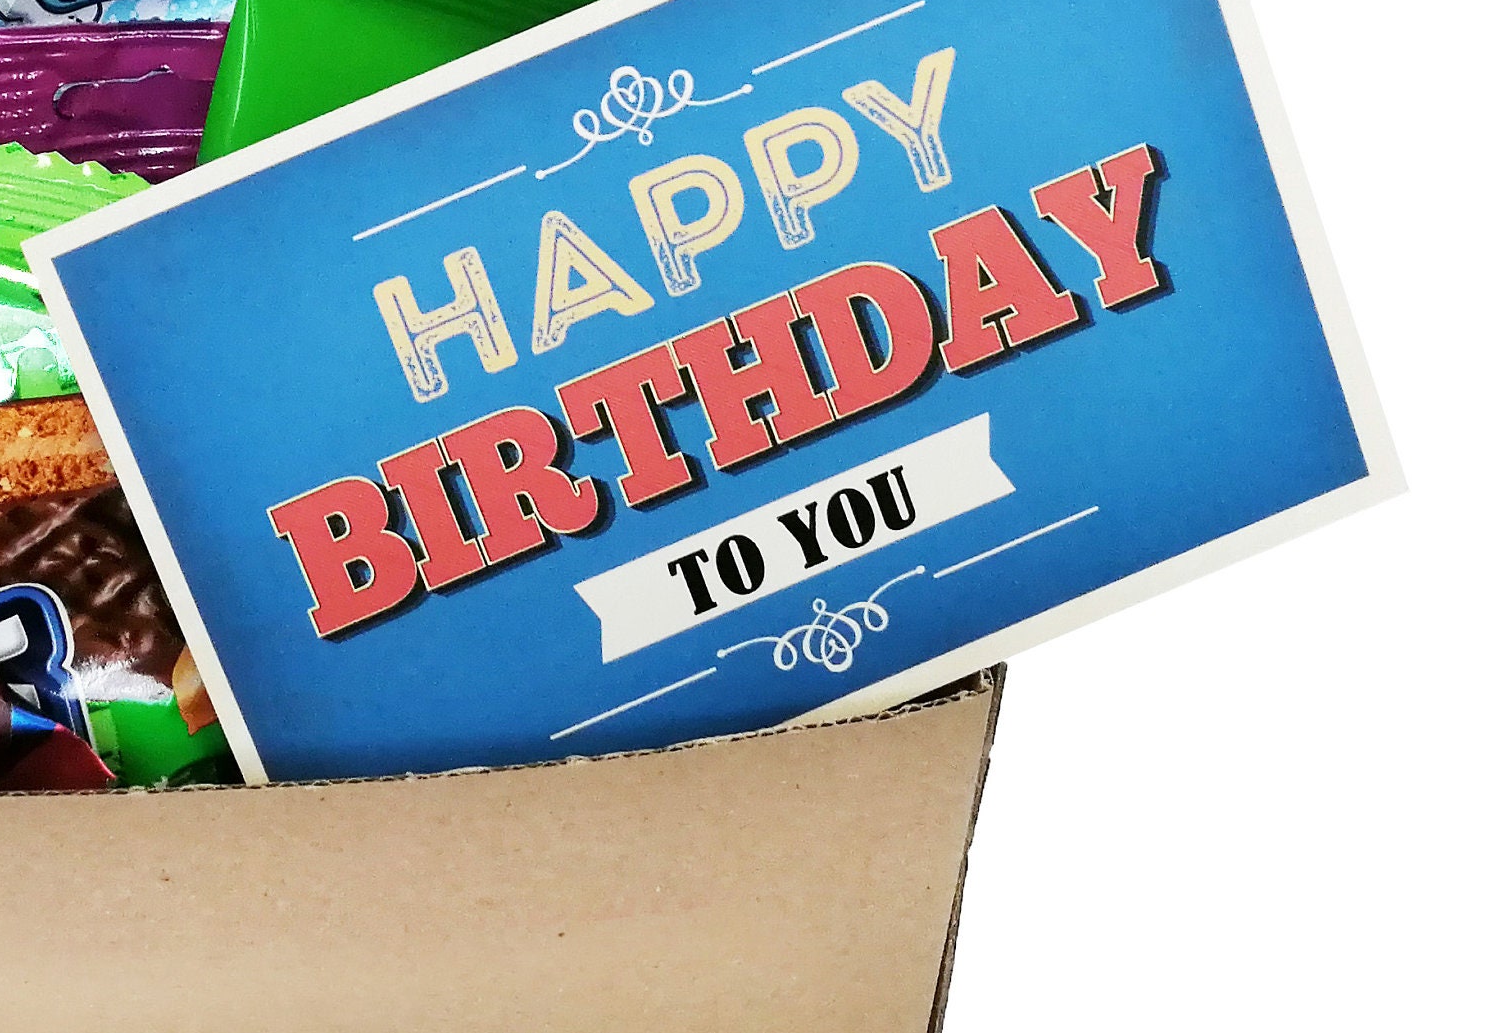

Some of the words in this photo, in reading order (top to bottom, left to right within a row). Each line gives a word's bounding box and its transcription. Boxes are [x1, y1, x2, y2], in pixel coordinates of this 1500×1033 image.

[268, 142, 1168, 640] BIRTHDAY
[371, 46, 956, 404] HAPPY
[667, 539, 765, 617] TO
[775, 465, 916, 571] YOU
